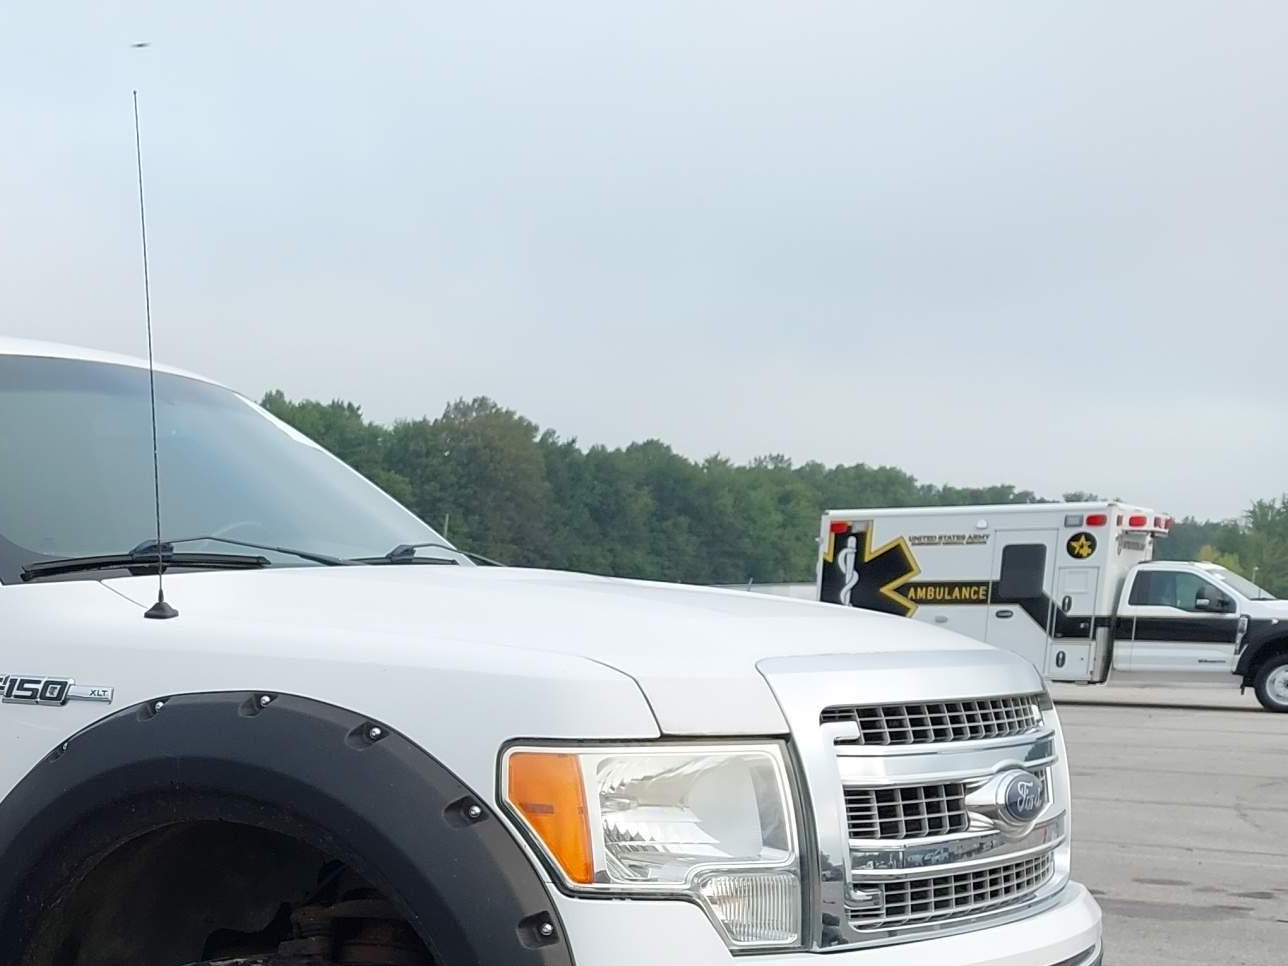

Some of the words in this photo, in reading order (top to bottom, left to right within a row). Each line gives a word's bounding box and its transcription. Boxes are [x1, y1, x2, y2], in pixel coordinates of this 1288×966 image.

[907, 585, 987, 600] AMBULANCE
[88, 689, 108, 697] XLT
[1016, 781, 1042, 813] Ford
